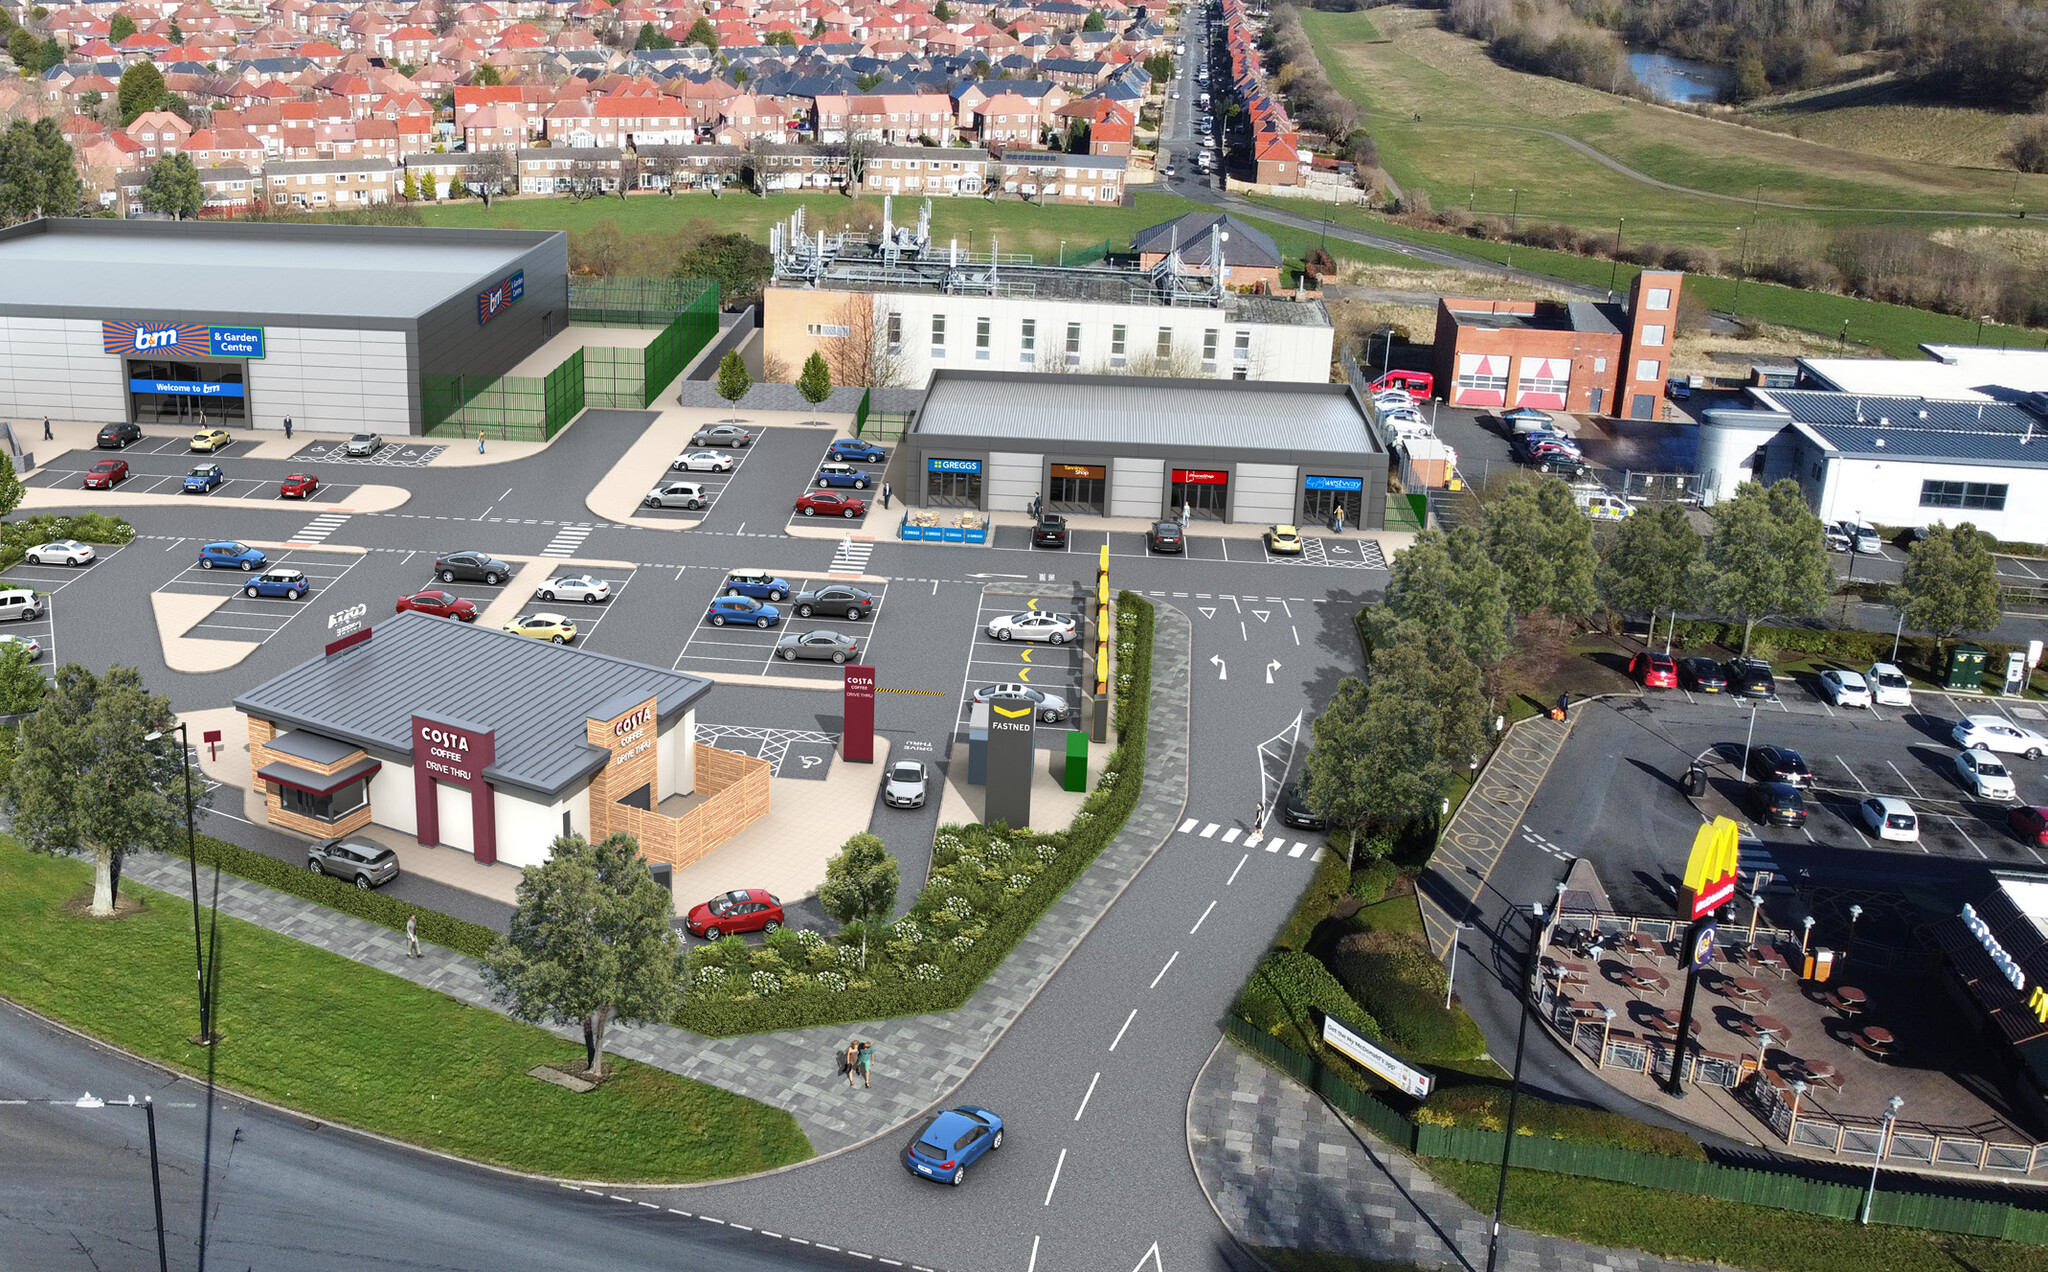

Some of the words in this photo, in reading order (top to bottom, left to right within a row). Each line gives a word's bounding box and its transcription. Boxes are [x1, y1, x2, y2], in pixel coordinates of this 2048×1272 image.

[214, 333, 222, 341] &
[223, 333, 258, 342] Garden
[221, 342, 253, 352] Centre
[156, 383, 191, 392] Welcome
[942, 461, 977, 470] GREGGS
[847, 677, 873, 685] COSTA
[615, 707, 651, 737] COSTA
[992, 721, 1031, 732] FASTNED
[421, 726, 470, 752] COSTA
[620, 728, 644, 748] COFFEE
[430, 747, 463, 763] COFFEE
[616, 748, 635, 766] DRIVE
[635, 739, 651, 755] THRU
[425, 760, 450, 775] DRIVE
[450, 766, 472, 781] THRU
[1327, 1024, 1338, 1034] Get
